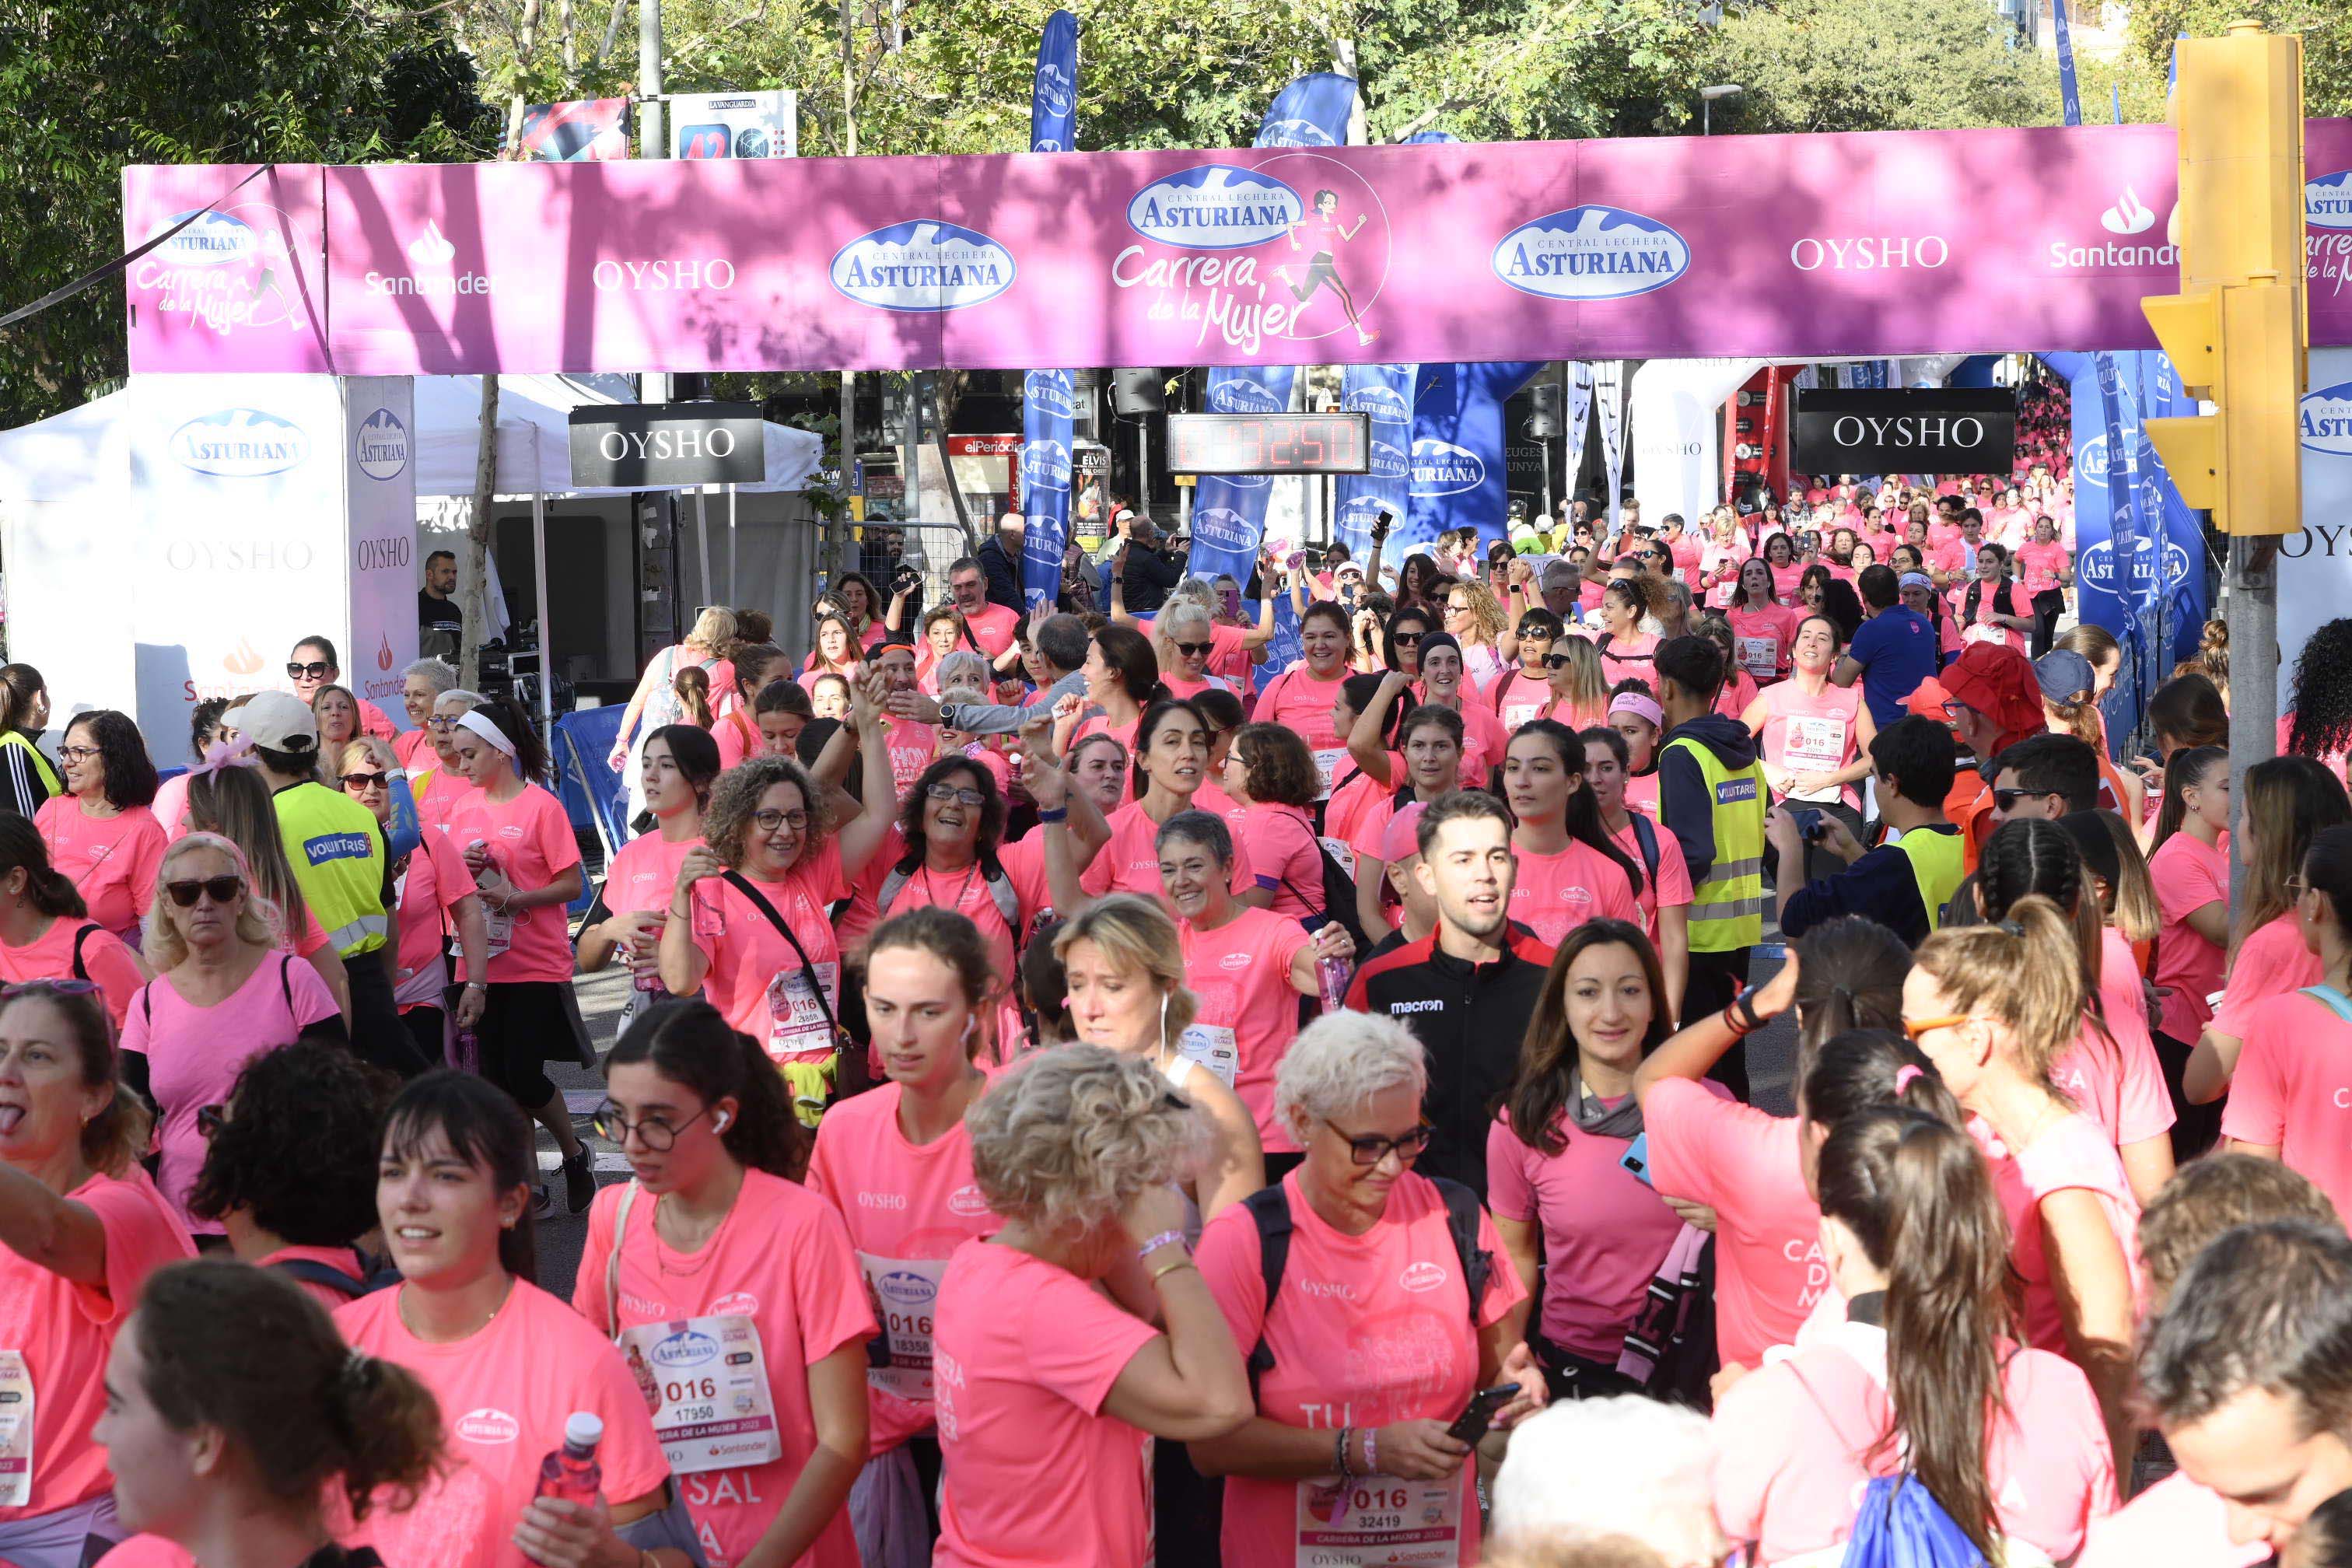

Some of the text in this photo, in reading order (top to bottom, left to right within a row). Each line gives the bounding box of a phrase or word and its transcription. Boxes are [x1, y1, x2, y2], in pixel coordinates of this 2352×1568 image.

[1167, 192, 1285, 204] CENTRAL LECHERA
[1140, 196, 1290, 228] ASTURIANA
[873, 249, 996, 261] CENTRAL LECHERA
[1538, 236, 1668, 249] CENTRAL LECHERA
[1790, 236, 1948, 271] OYSHO
[2049, 242, 2182, 268] Santand
[844, 254, 1002, 288] ASTURIANA
[1112, 244, 1258, 289] Carrera
[1507, 242, 1675, 277] ASTURIANA
[2322, 257, 2337, 278] la
[136, 261, 227, 291] Carrera
[364, 271, 499, 296] Santnder
[592, 259, 735, 291] OYSHO
[190, 287, 261, 335] Mujer
[1147, 282, 1312, 356] de la Mujer
[600, 428, 735, 461] OYSHO
[1833, 416, 1983, 448] OYSHO
[359, 434, 405, 464] ASTURIANA
[1082, 456, 1107, 466] ELVIS
[1195, 518, 1251, 547] ASTURIANA
[2278, 525, 2352, 558] OY
[358, 537, 410, 572] OYSHO
[1805, 737, 1825, 747] 016
[792, 998, 817, 1012] 016
[1391, 999, 1444, 1014] macron
[858, 1191, 908, 1210] OYSHO
[889, 1313, 933, 1335] 016
[895, 1339, 930, 1353] 18358
[667, 1377, 716, 1402] 016
[675, 1405, 715, 1422] 17950
[708, 1423, 738, 1436] MUJER
[720, 1440, 768, 1456] Santander
[688, 1471, 762, 1507] SAL
[1354, 1489, 1408, 1510] 016
[1359, 1515, 1402, 1529] 32419
[1317, 1534, 1360, 1545] CARRERA
[1364, 1535, 1376, 1544] DE
[1377, 1534, 1389, 1543] LA
[1391, 1531, 1421, 1542] MUJER
[1312, 1549, 1447, 1566] OYSHO Santander
